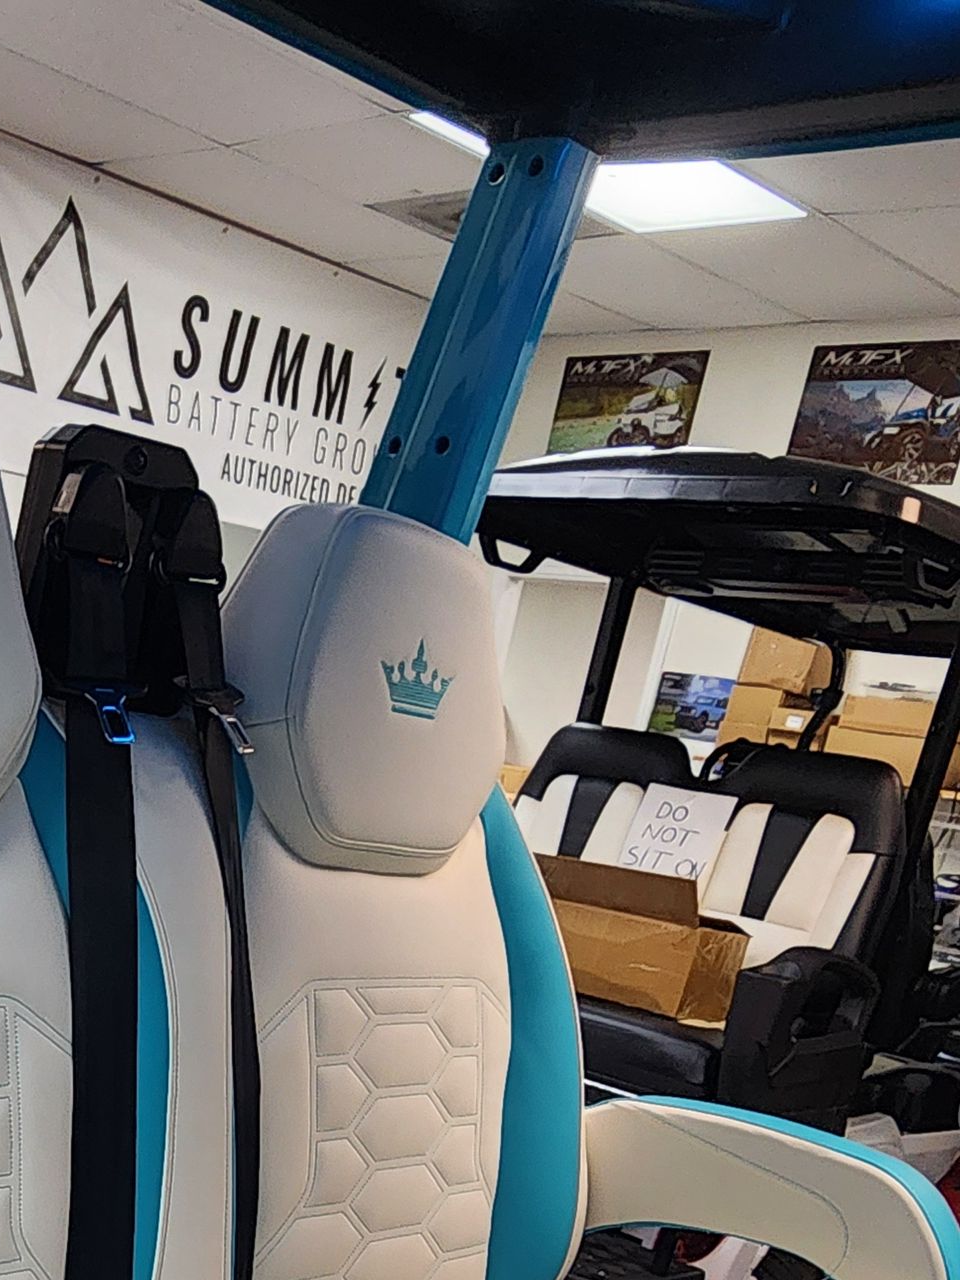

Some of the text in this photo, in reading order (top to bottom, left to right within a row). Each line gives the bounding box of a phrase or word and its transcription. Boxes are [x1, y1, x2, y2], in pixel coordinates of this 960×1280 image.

[166, 383, 379, 476] BATTERY GRO
[220, 452, 331, 505] AUTHORIZED
[655, 801, 689, 823] DO
[641, 823, 700, 847] NOT
[623, 846, 674, 870] SIT
